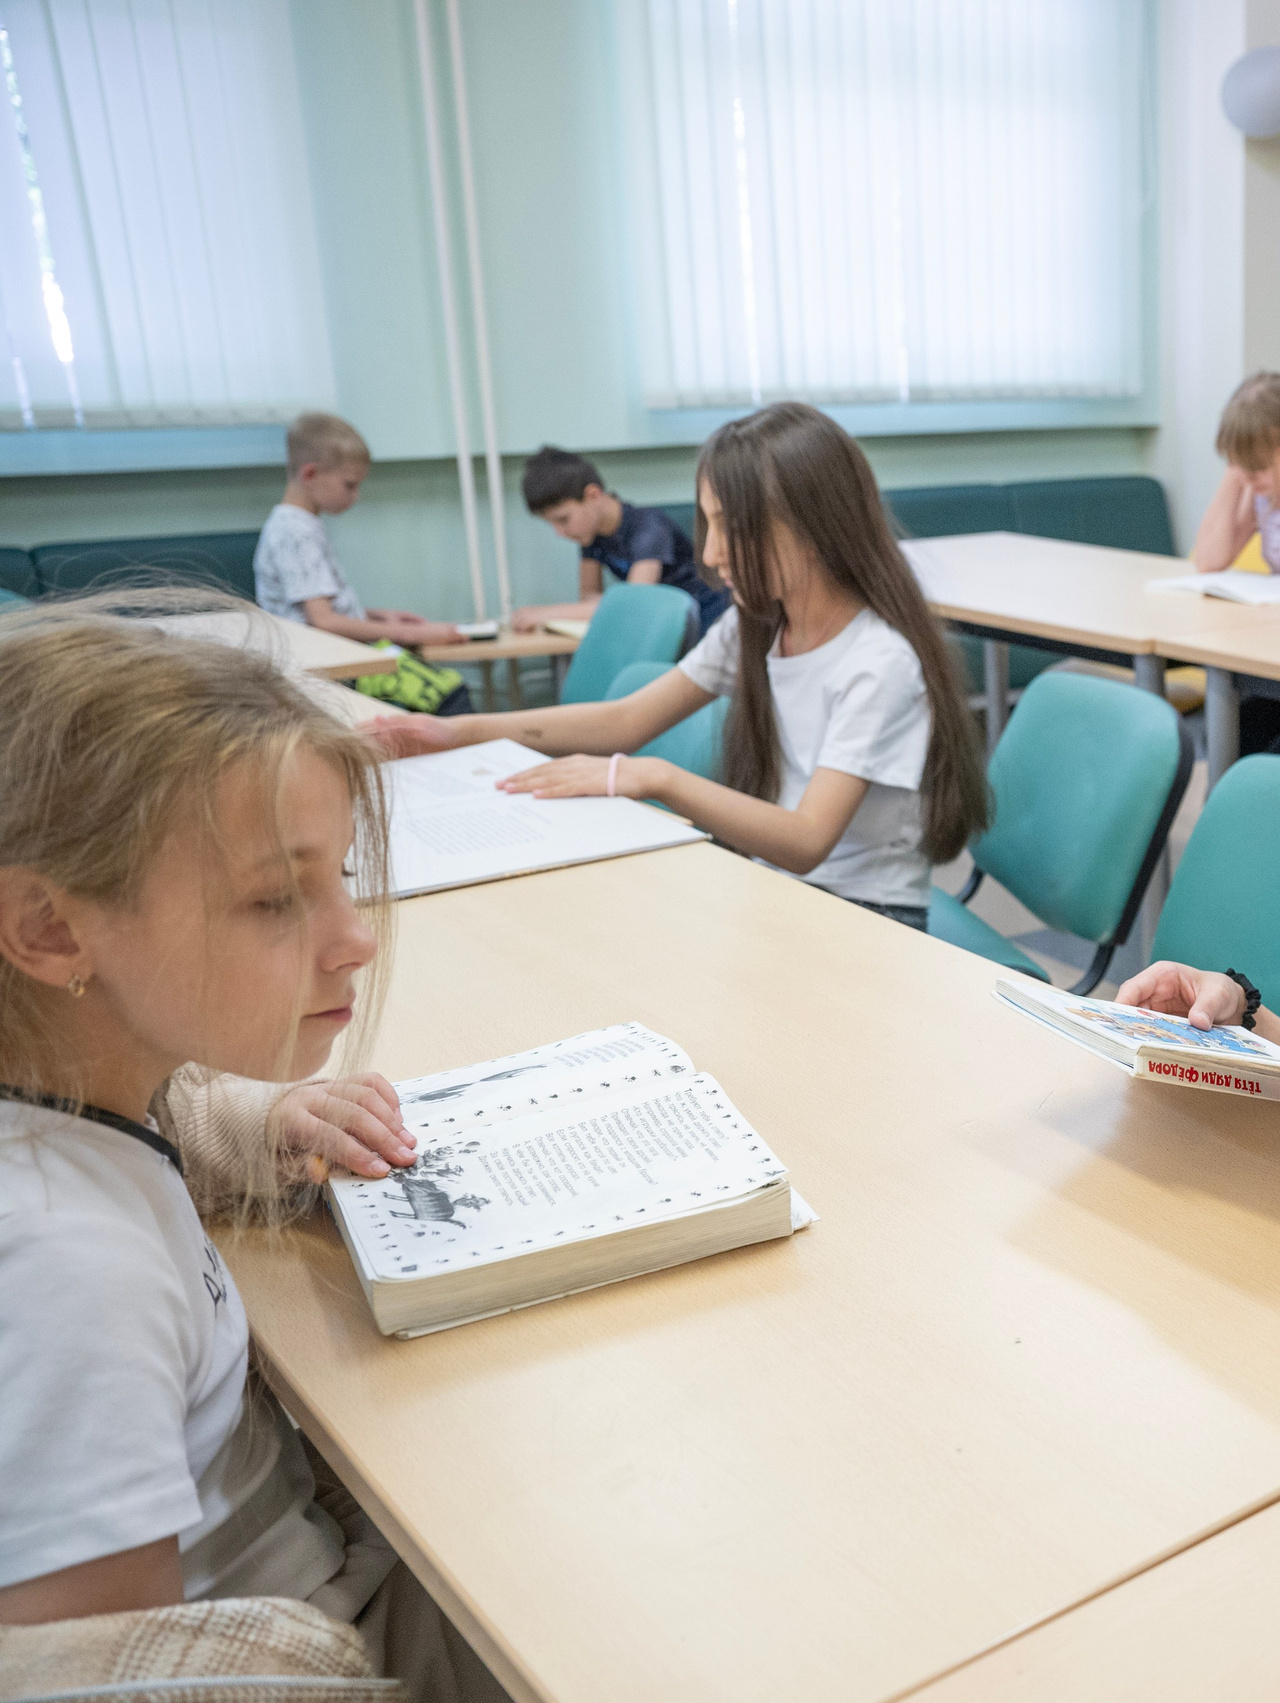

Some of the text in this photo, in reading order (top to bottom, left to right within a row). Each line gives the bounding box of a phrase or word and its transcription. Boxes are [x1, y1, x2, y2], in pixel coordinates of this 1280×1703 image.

[1149, 1061, 1262, 1095] ТЁТЯ ДЯДИ ФЁДОРА
